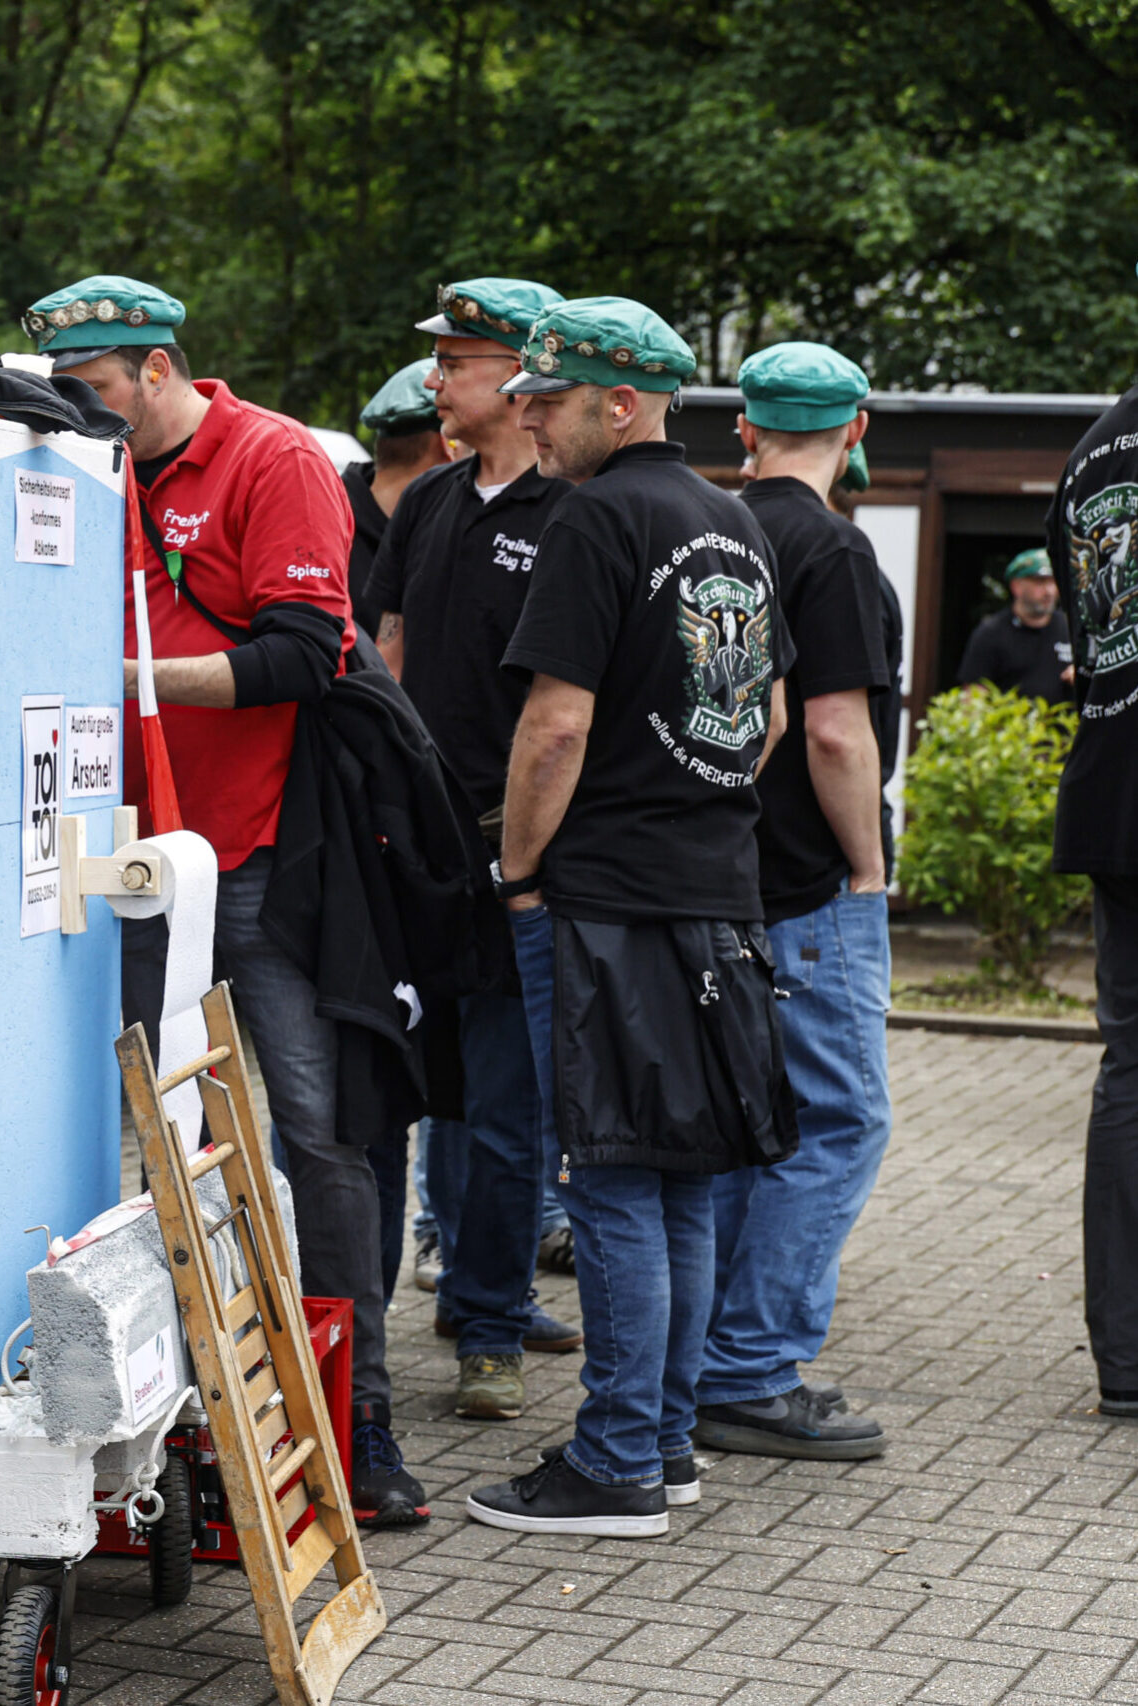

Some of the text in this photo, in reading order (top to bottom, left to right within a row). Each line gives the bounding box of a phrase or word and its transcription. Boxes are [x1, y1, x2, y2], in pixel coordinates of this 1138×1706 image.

[164, 527, 200, 547] Zug 5
[493, 550, 534, 571] Zug 5
[672, 545, 691, 565] die
[286, 564, 331, 581] Spiess
[648, 712, 675, 750] sollen
[673, 746, 688, 765] die
[688, 757, 744, 788] FREIHEIT
[72, 748, 112, 790] Ärsche!
[32, 807, 56, 861] TOI
